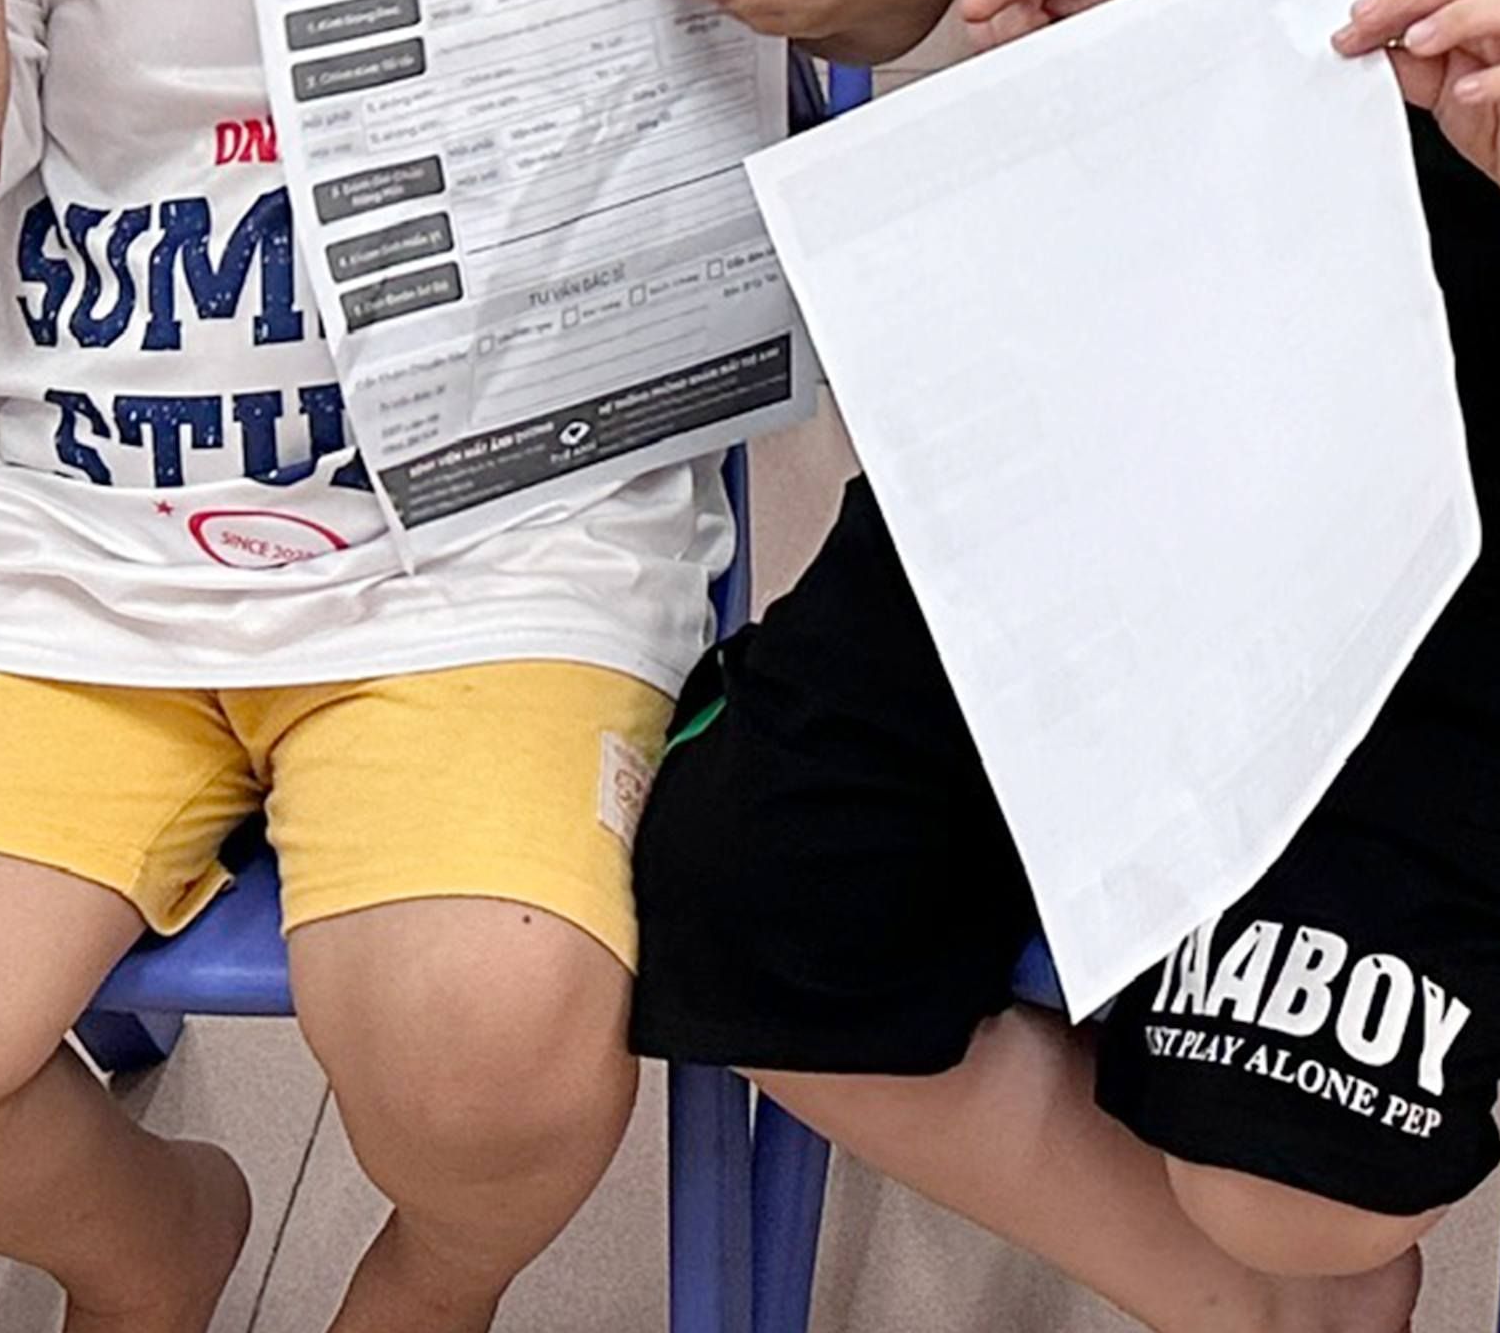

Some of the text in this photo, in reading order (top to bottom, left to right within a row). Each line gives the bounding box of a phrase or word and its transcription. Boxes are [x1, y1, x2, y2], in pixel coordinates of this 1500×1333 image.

[16, 186, 326, 351] SUM
[220, 530, 271, 559] SINCE
[1176, 1028, 1245, 1065] PLAY
[1244, 1044, 1380, 1117] ALONE
[1381, 1094, 1443, 1139] PEP
